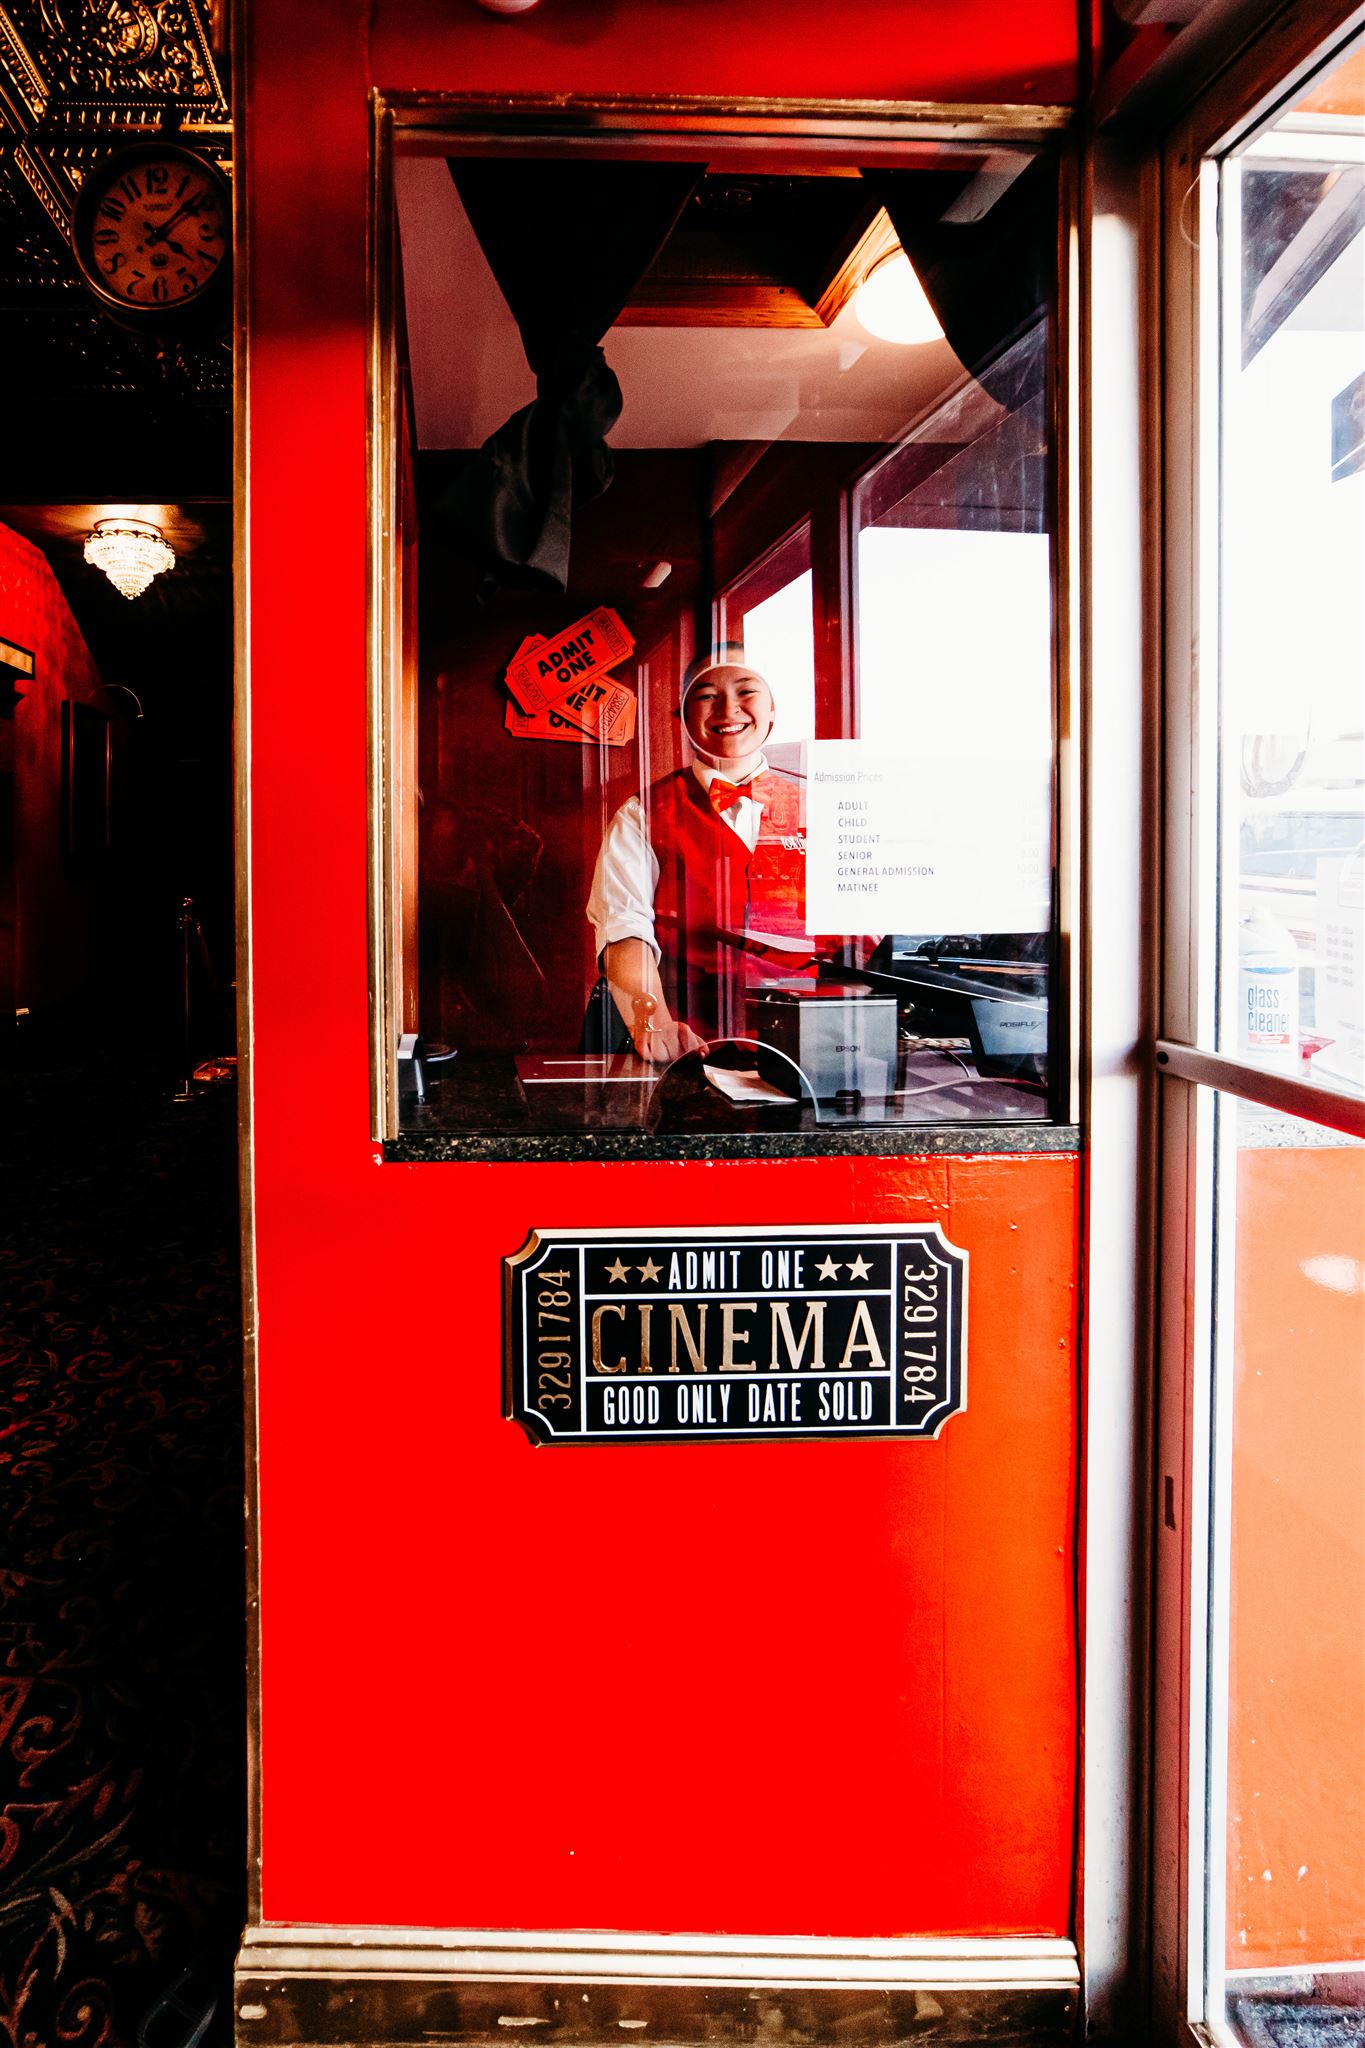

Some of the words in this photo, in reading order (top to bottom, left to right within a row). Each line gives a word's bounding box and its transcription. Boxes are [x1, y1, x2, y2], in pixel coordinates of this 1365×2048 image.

[145, 167, 169, 195] 12
[103, 252, 126, 275] 8
[126, 270, 146, 296] 7
[152, 276, 168, 301] 6
[536, 629, 595, 678] ADMIT
[556, 651, 596, 683] ONE
[814, 771, 856, 783] Admission
[857, 771, 884, 783] Prices
[838, 801, 869, 812] ADULT
[838, 817, 867, 828] CHILD
[838, 834, 881, 845] STUDENT
[838, 851, 873, 861] SENIOR
[837, 867, 879, 877] GENERAL
[881, 866, 935, 877] ADMISSION
[837, 883, 879, 893] MATINEE
[1247, 985, 1280, 1010] glass
[1247, 1010, 1290, 1033] cleaner
[835, 1045, 861, 1053] EPSON
[668, 1250, 741, 1290] ADMIT
[761, 1250, 805, 1289] ONE
[538, 1268, 572, 1411] 3291784
[591, 1300, 886, 1374] CINEMA
[903, 1264, 938, 1403] 3291784
[603, 1384, 659, 1425] GOOD
[677, 1383, 731, 1424] ONLY
[748, 1382, 802, 1423] DATE
[818, 1380, 873, 1422] SOLD
